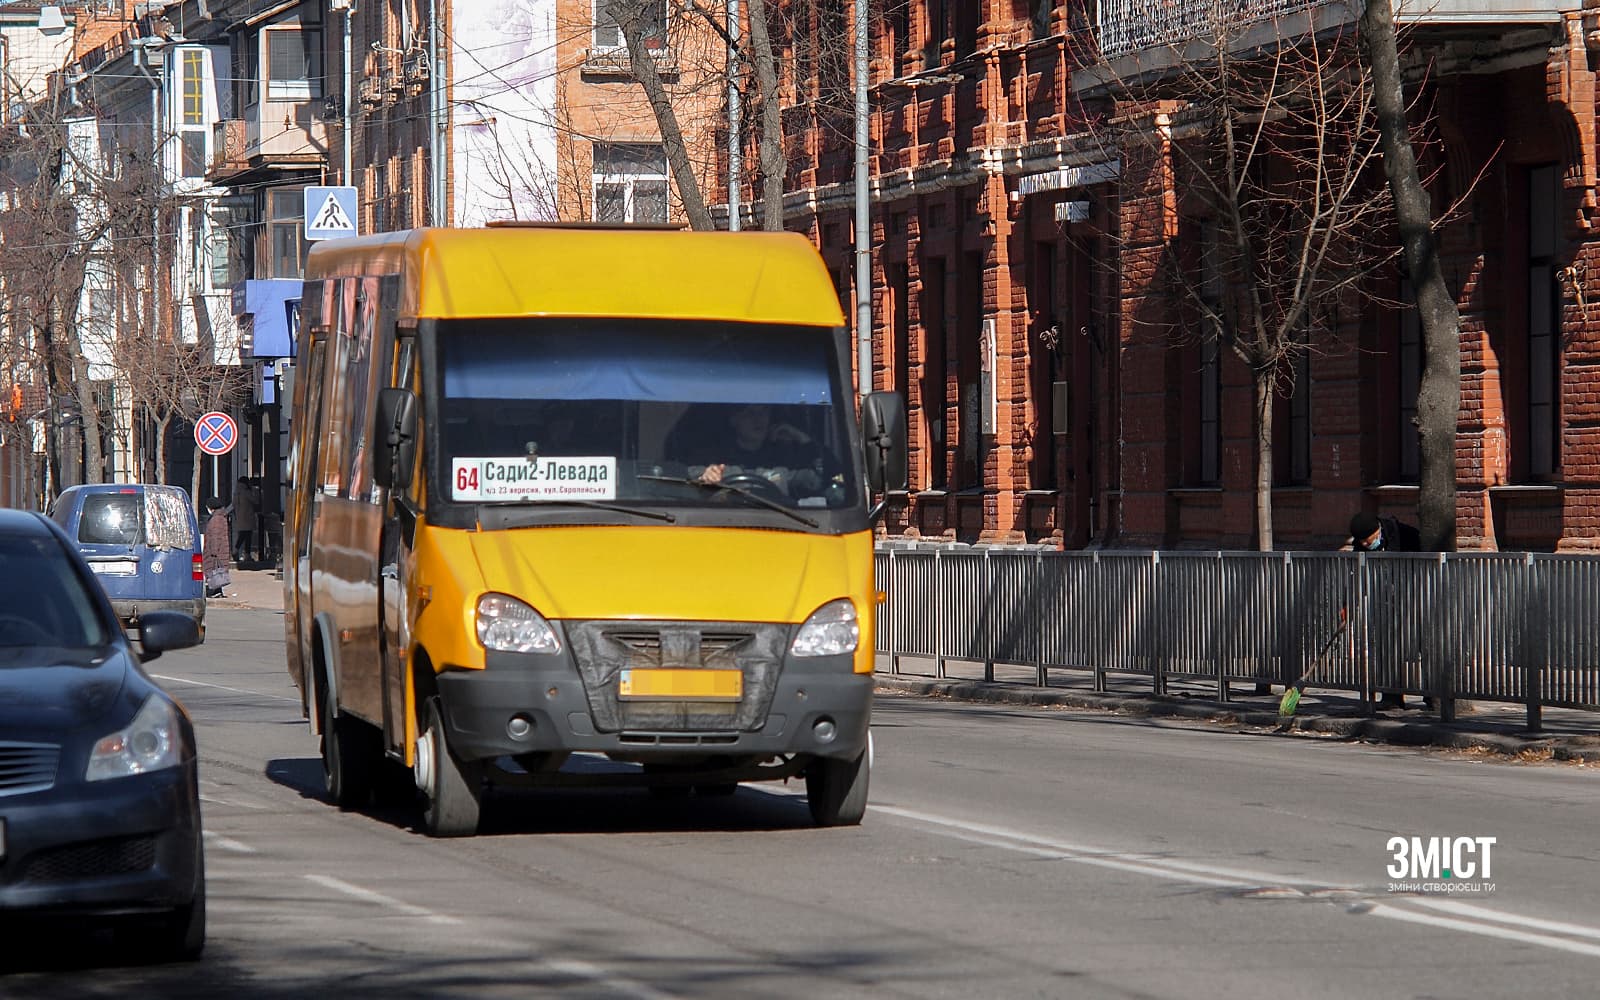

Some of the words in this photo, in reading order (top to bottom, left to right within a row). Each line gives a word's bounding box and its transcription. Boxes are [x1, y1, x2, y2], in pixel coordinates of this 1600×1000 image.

[456, 467, 479, 491] 64
[485, 461, 608, 483] Сади2-Левада
[498, 486, 507, 495] 23
